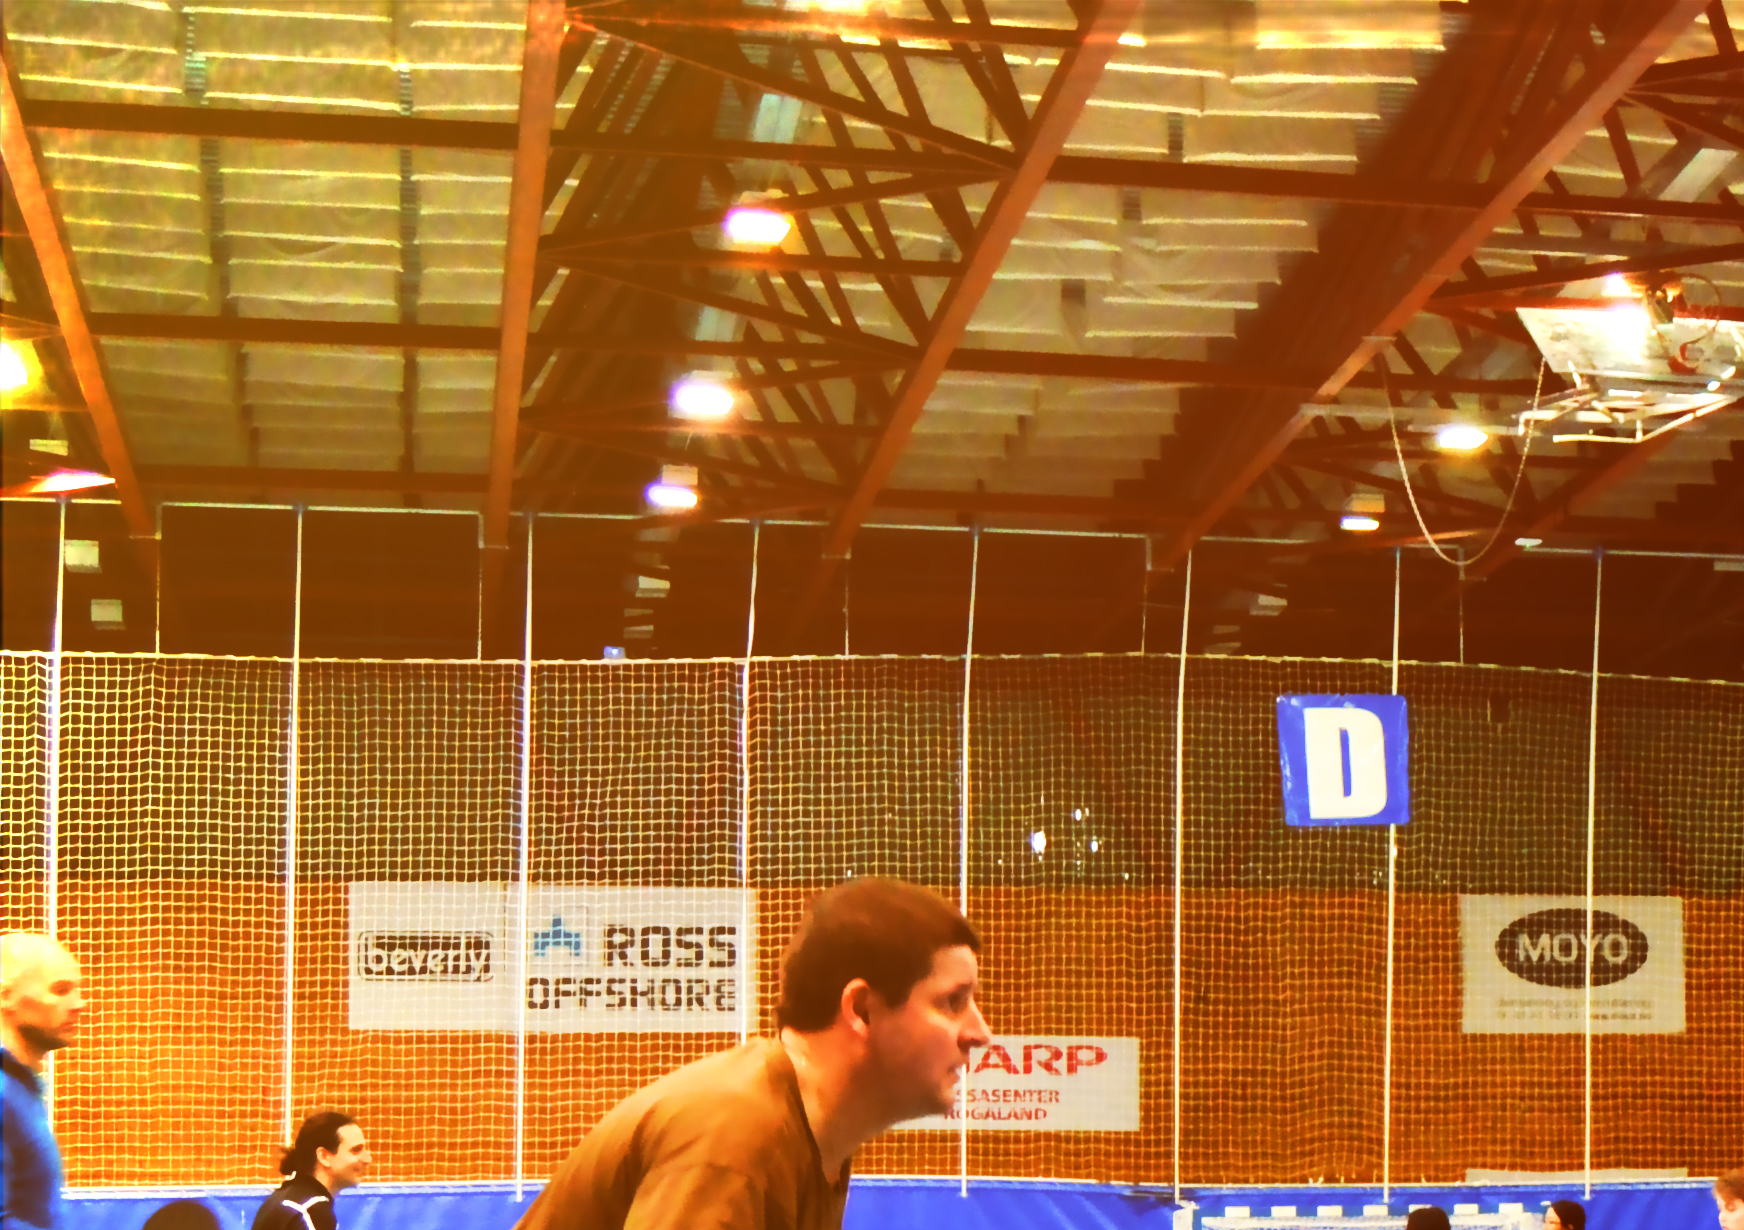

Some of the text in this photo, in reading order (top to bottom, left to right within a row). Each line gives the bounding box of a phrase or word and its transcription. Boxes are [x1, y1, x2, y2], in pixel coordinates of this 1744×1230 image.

[1303, 707, 1388, 819] D
[606, 925, 737, 968] ROSS
[1518, 933, 1629, 965] MOYO
[527, 978, 736, 1012] OFFSHORE
[966, 1044, 1108, 1076] ARP
